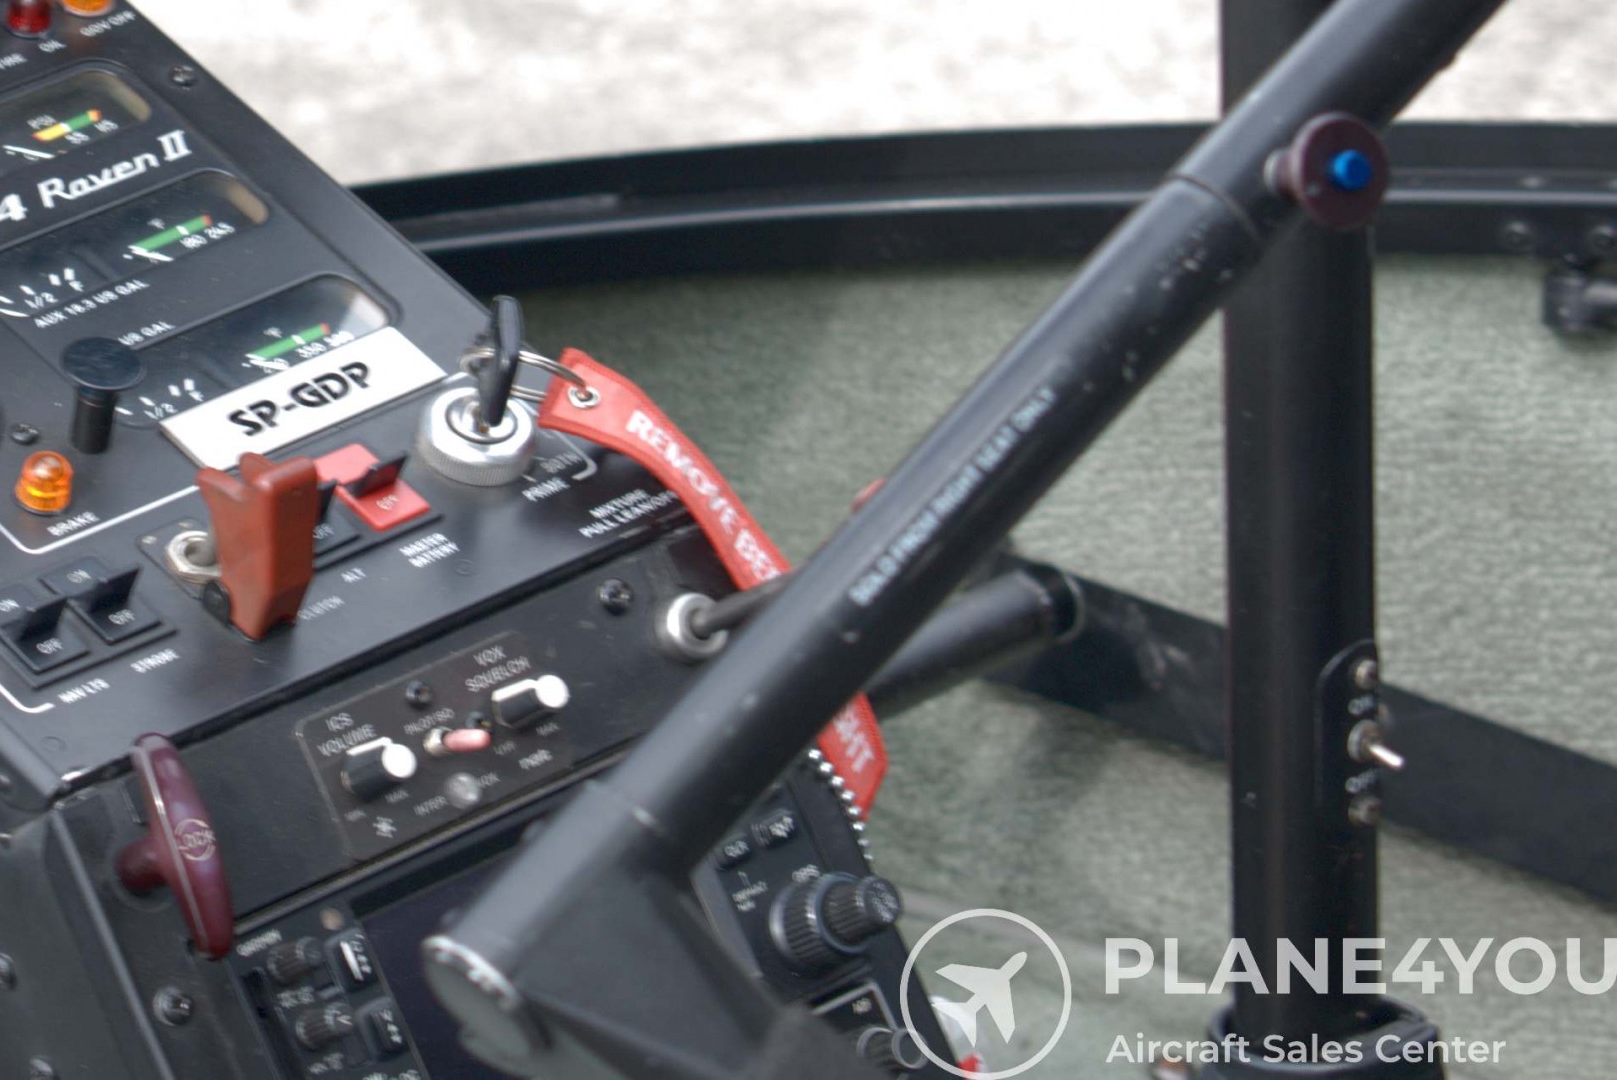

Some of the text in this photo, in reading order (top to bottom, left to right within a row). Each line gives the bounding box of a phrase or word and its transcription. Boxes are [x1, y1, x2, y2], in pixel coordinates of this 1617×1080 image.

[79, 19, 113, 38] GOV
[36, 151, 160, 209] Raven
[157, 129, 192, 162] II
[24, 292, 59, 310] 1/2
[34, 310, 68, 328] AUX
[92, 289, 118, 305] US
[115, 279, 150, 296] GAL
[118, 320, 176, 347] US GAL
[228, 361, 371, 437] SP-GDP
[931, 464, 983, 516] RIGHT
[975, 425, 1019, 473] SEAT
[1011, 385, 1057, 432] ONLY
[626, 410, 739, 534] REMOVE
[376, 494, 400, 510] OFF
[522, 478, 571, 503] PRIME
[589, 488, 650, 519] MIXTURE
[46, 511, 100, 537] BRAKE
[578, 517, 619, 539] PULL
[399, 532, 450, 558] MASTER
[408, 542, 460, 568] BATTERY
[67, 569, 92, 584] ON
[340, 567, 366, 584] ALT
[108, 609, 137, 626] OFF
[36, 639, 64, 655] OFF
[473, 644, 508, 668] VOX
[130, 648, 182, 674] STROBE
[464, 656, 531, 693] SQUELCH
[57, 678, 111, 705] NAV LTS
[325, 711, 354, 733] ICS
[317, 723, 377, 758] VOLUME
